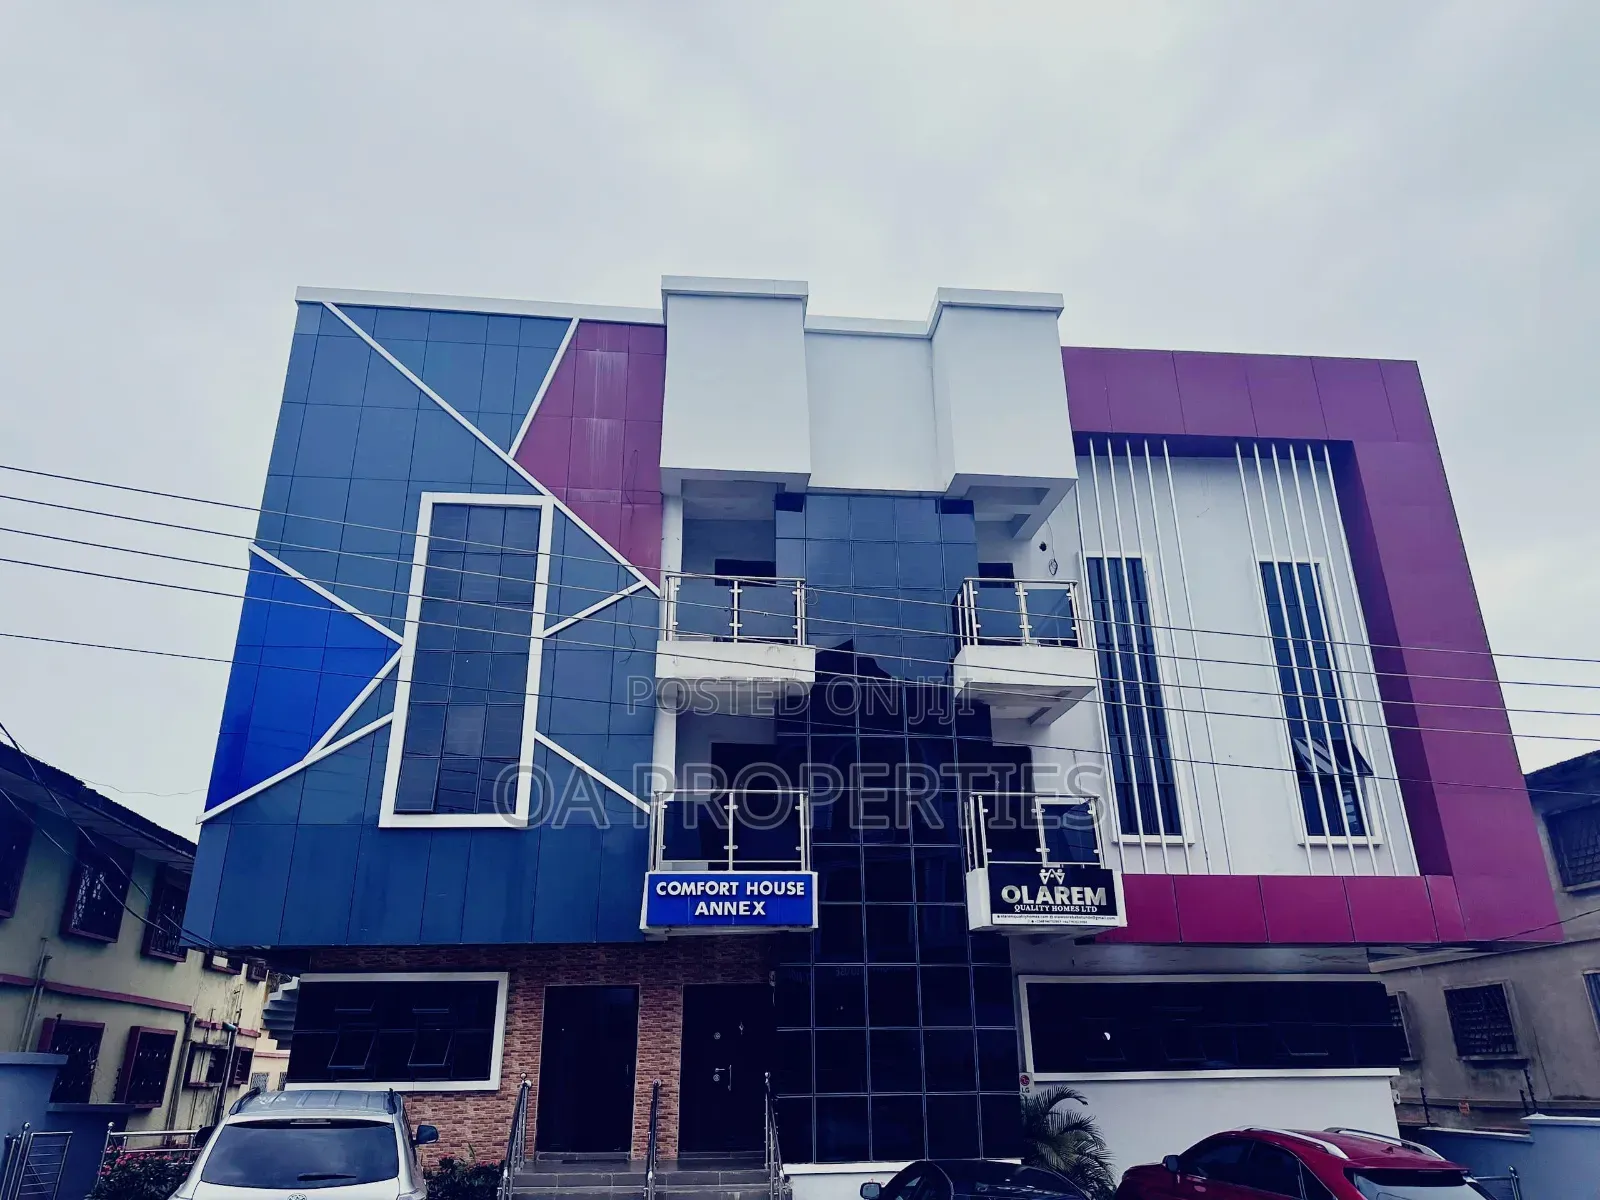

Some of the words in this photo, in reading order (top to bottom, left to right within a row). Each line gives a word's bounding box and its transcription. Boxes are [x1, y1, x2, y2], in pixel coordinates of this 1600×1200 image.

[655, 880, 739, 896] COMFORT
[746, 881, 805, 896] HOUSE
[1001, 885, 1107, 906] OLAREM
[694, 901, 766, 916] ANNEX
[1014, 904, 1050, 912] QUALITY
[1081, 905, 1098, 913] LTD
